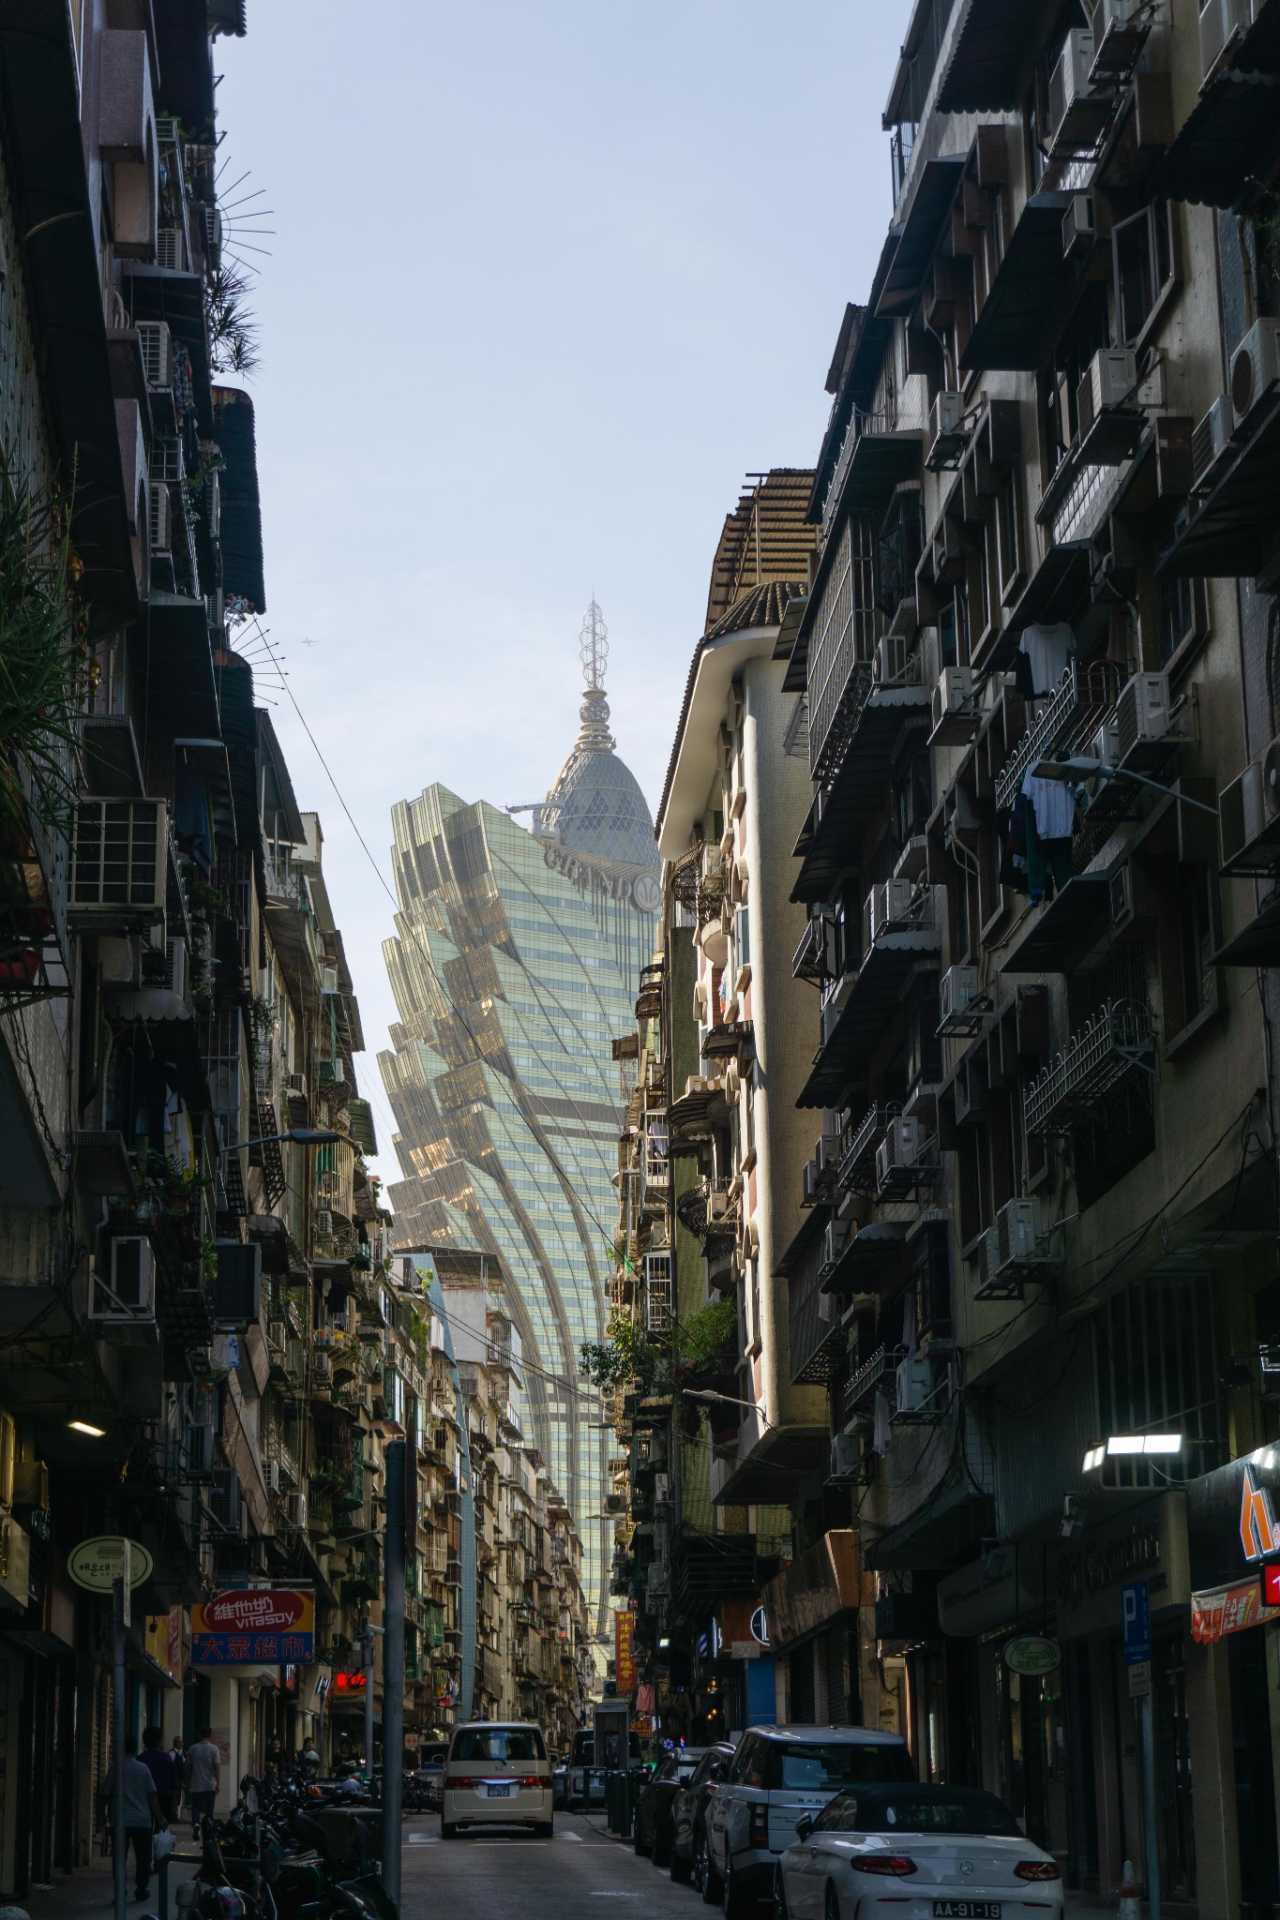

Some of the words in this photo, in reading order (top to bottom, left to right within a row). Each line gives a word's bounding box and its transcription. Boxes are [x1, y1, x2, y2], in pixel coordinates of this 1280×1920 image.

[214, 1596, 274, 1620] 維他奶
[1123, 1589, 1137, 1642] P
[936, 1903, 1000, 1918] AA-91-19
